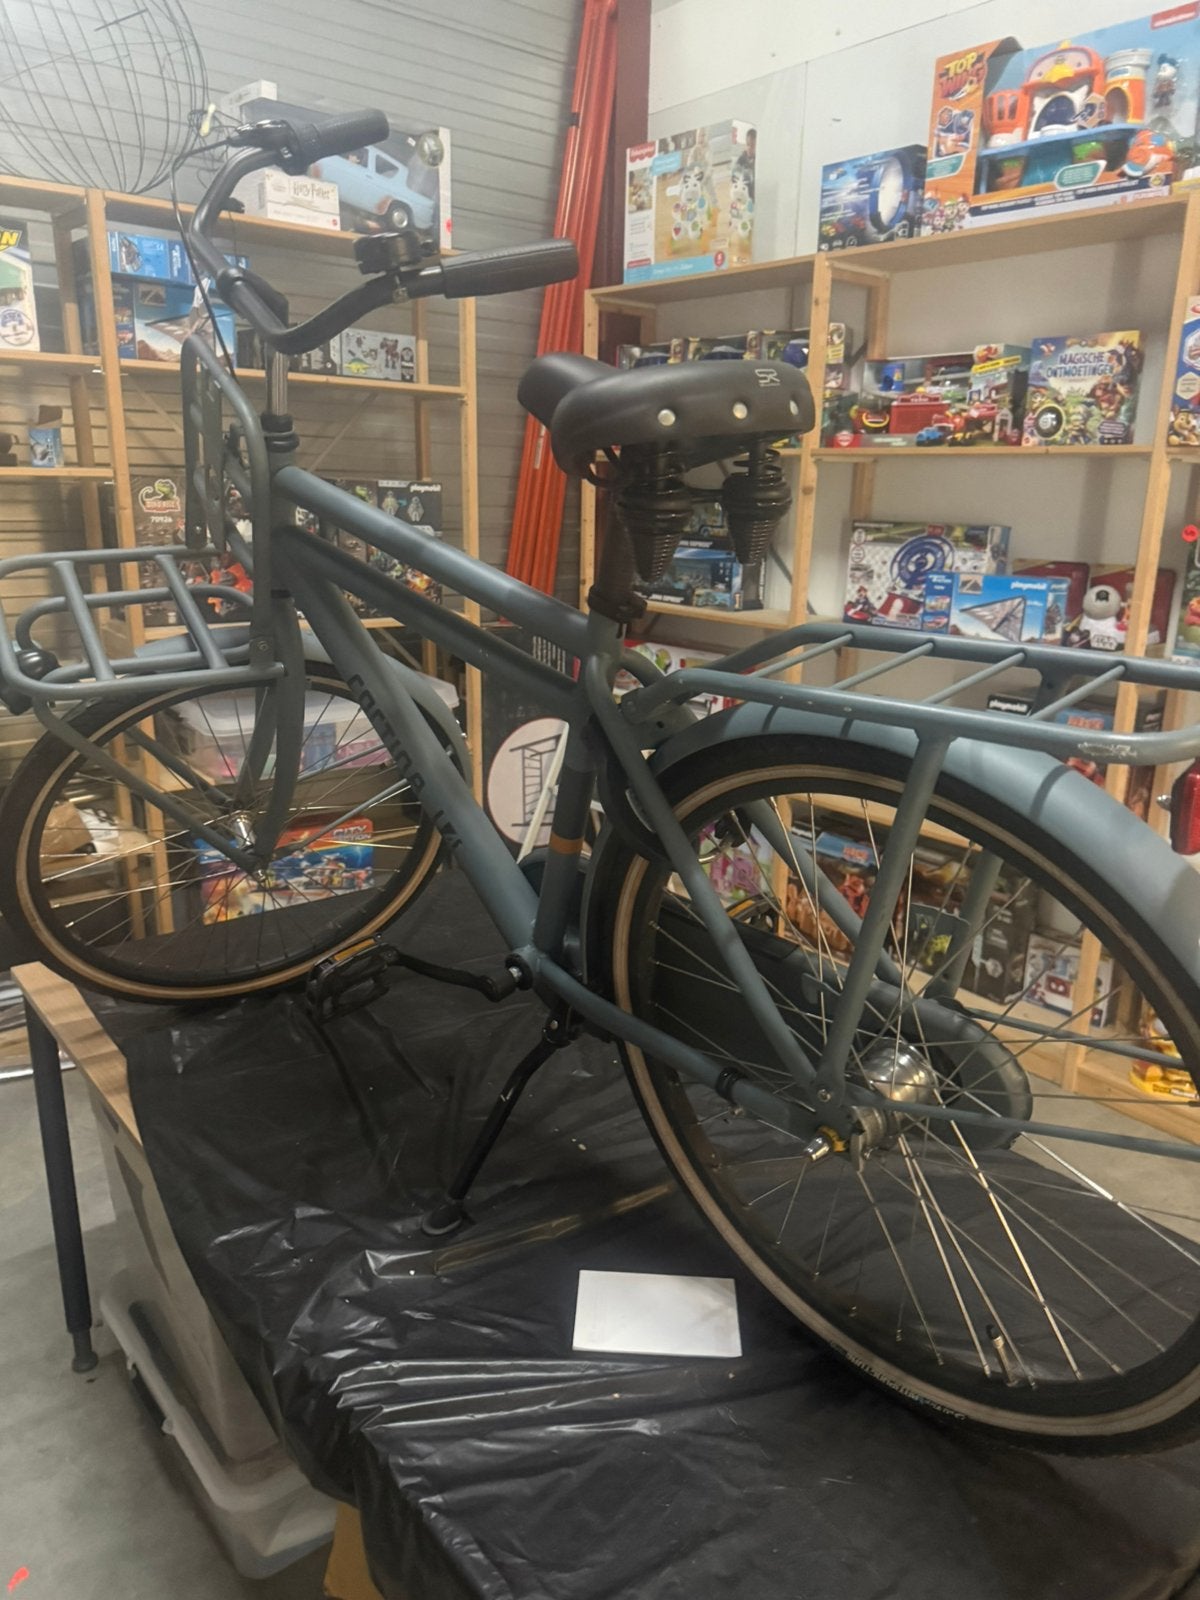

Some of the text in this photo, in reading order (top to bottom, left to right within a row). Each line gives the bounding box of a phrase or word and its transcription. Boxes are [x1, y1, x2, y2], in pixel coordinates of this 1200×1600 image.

[944, 52, 977, 77] TOP
[1059, 352, 1104, 364] MAGISCHE
[410, 483, 441, 493] playmobil
[1010, 580, 1047, 591] playmobil
[989, 700, 1028, 713] playmobil
